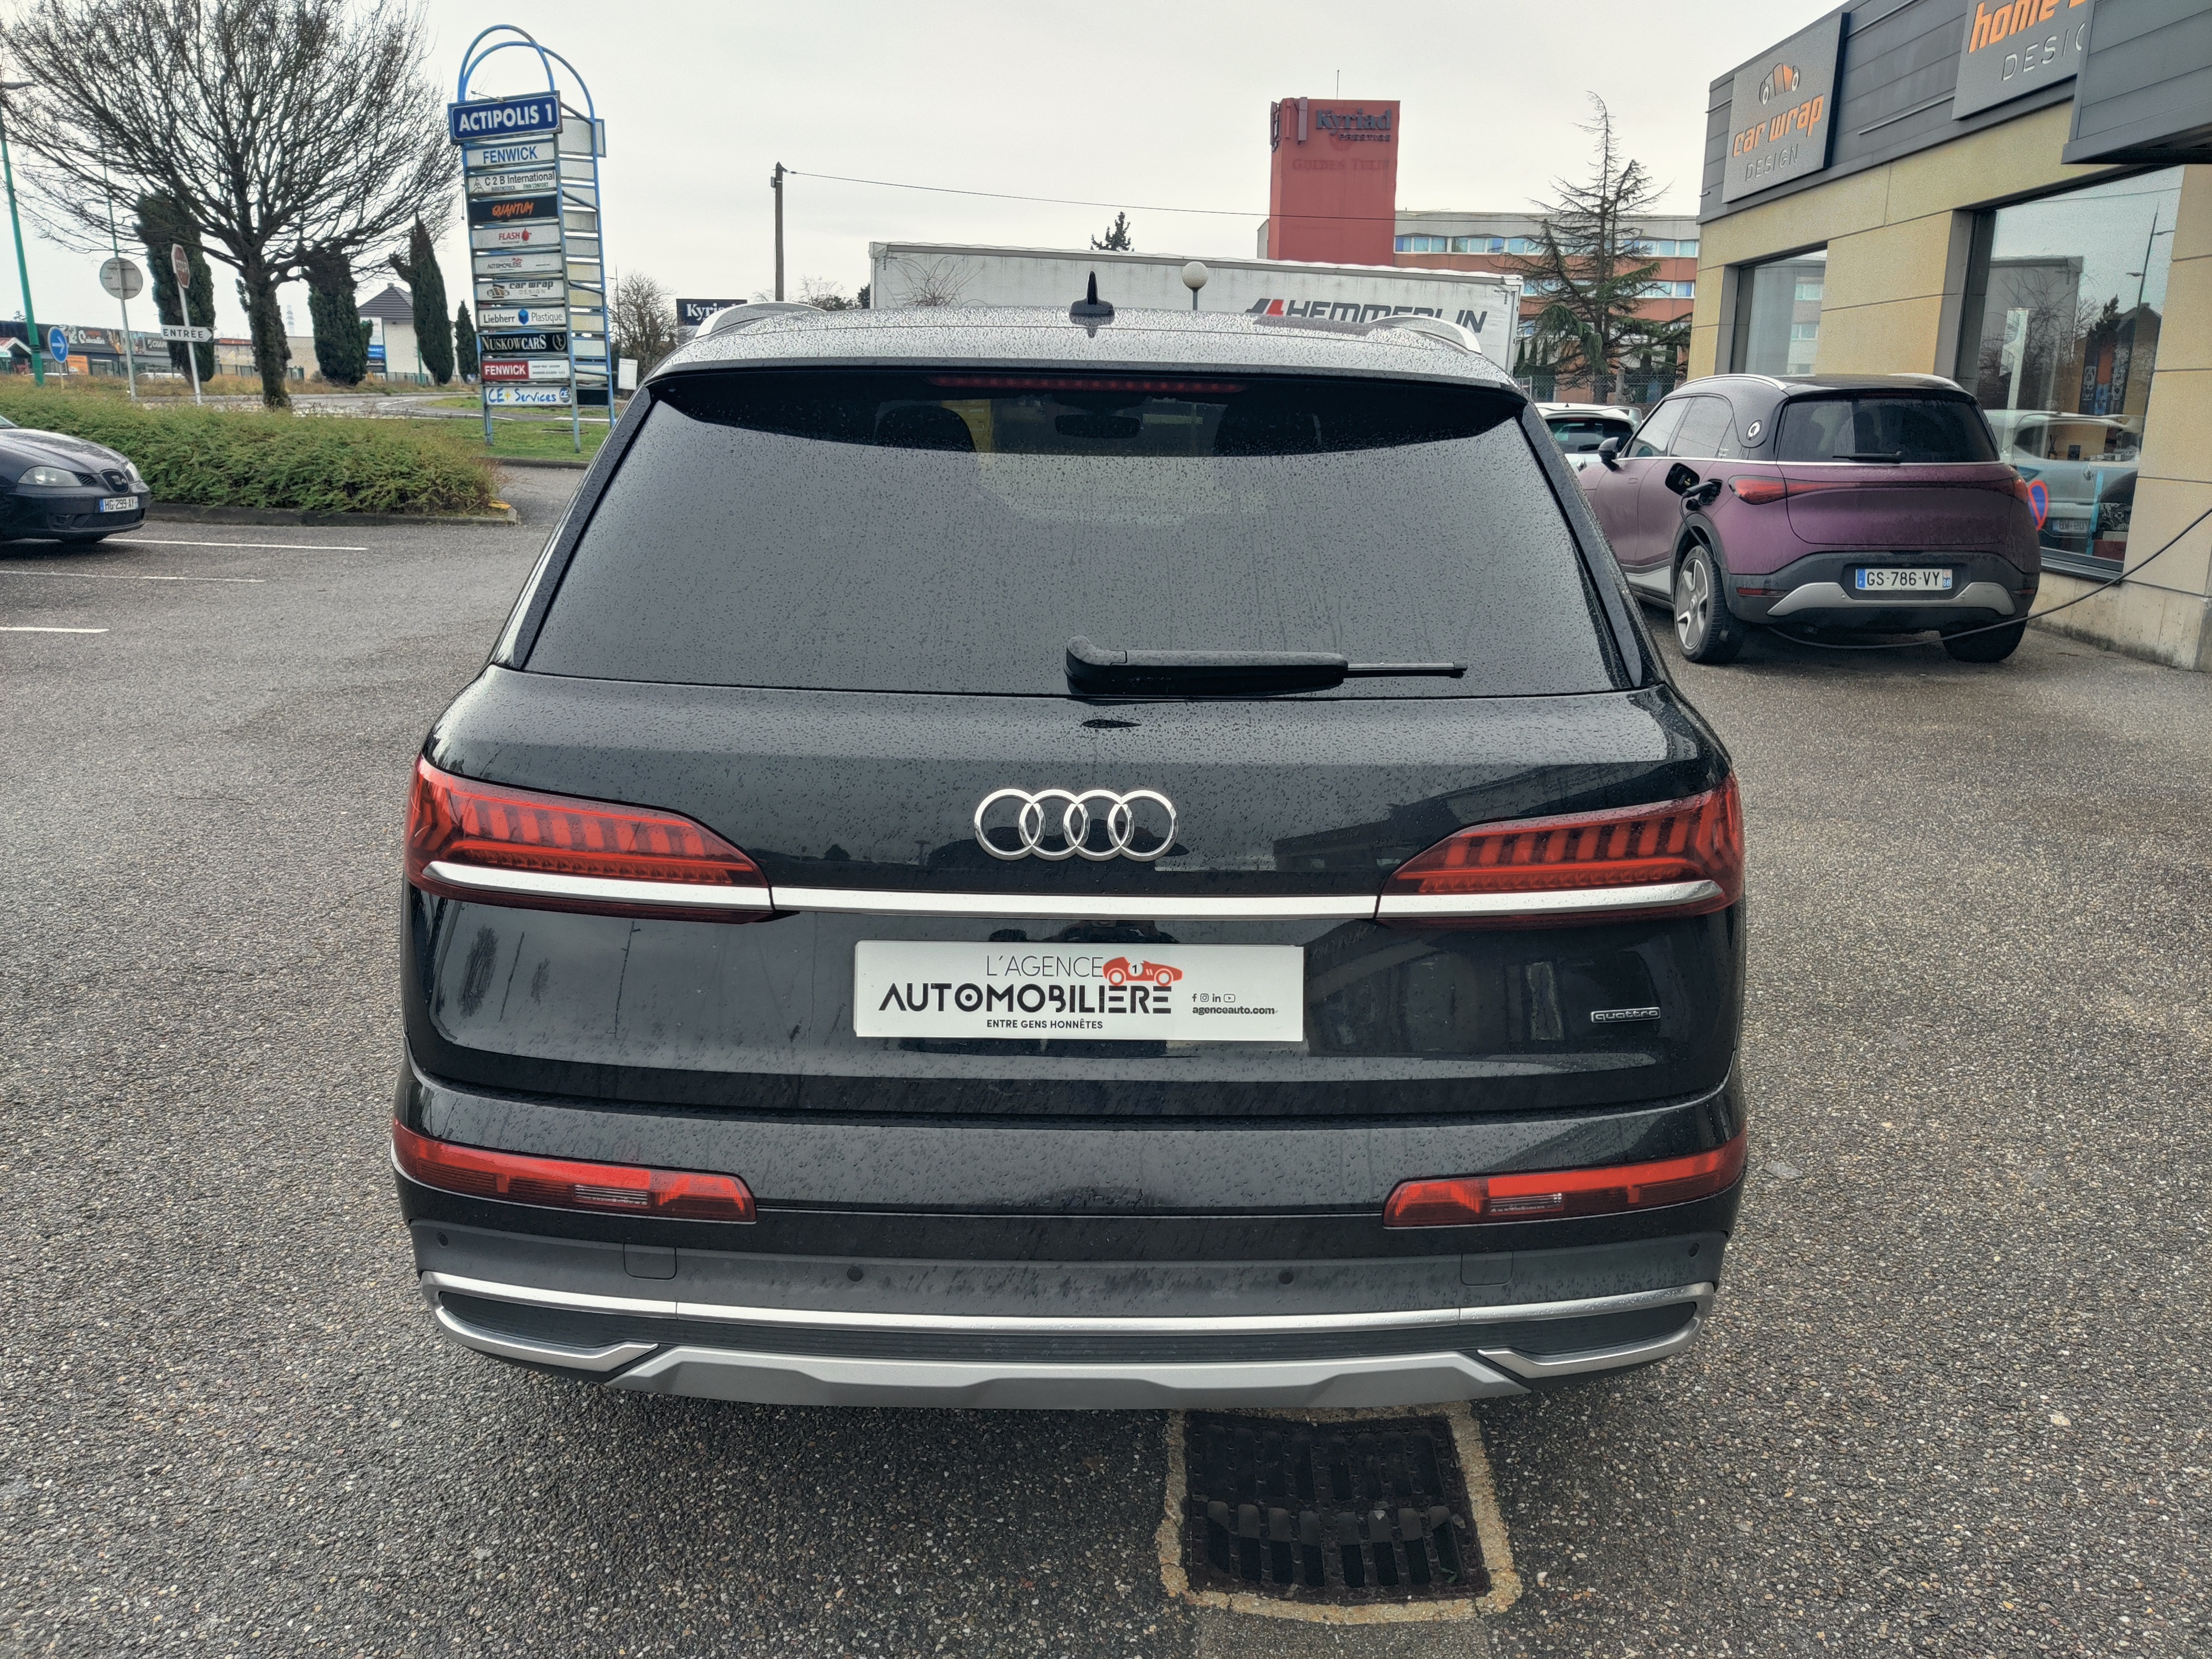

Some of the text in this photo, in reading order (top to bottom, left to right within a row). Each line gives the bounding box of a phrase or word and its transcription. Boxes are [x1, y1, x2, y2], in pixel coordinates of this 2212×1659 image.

[2001, 21, 2086, 81] DESI
[459, 104, 552, 132] ACTIPOLIS 1
[1316, 108, 1391, 135] Kyriad
[1732, 93, 1824, 158] car wrap
[1338, 133, 1391, 142] PRESTIGE
[483, 145, 538, 164] FENWICK
[1745, 143, 1798, 181] DESIGN
[485, 171, 555, 186] C 2 B International
[492, 201, 534, 218] QUANTUM
[529, 281, 554, 290] wrap
[483, 312, 563, 324] Liebherr Plastique
[163, 328, 204, 338] ENTRÉE
[484, 364, 526, 375] FENWICK
[514, 388, 557, 402] Services
[1867, 571, 1940, 586] GS-786-VY
[987, 955, 1104, 977] L'AGENCE
[1192, 1006, 1275, 1015] agenceauto.com
[1595, 1010, 1658, 1021] quattro
[987, 1019, 1103, 1030] ENTRE GENS HONNÊTES
